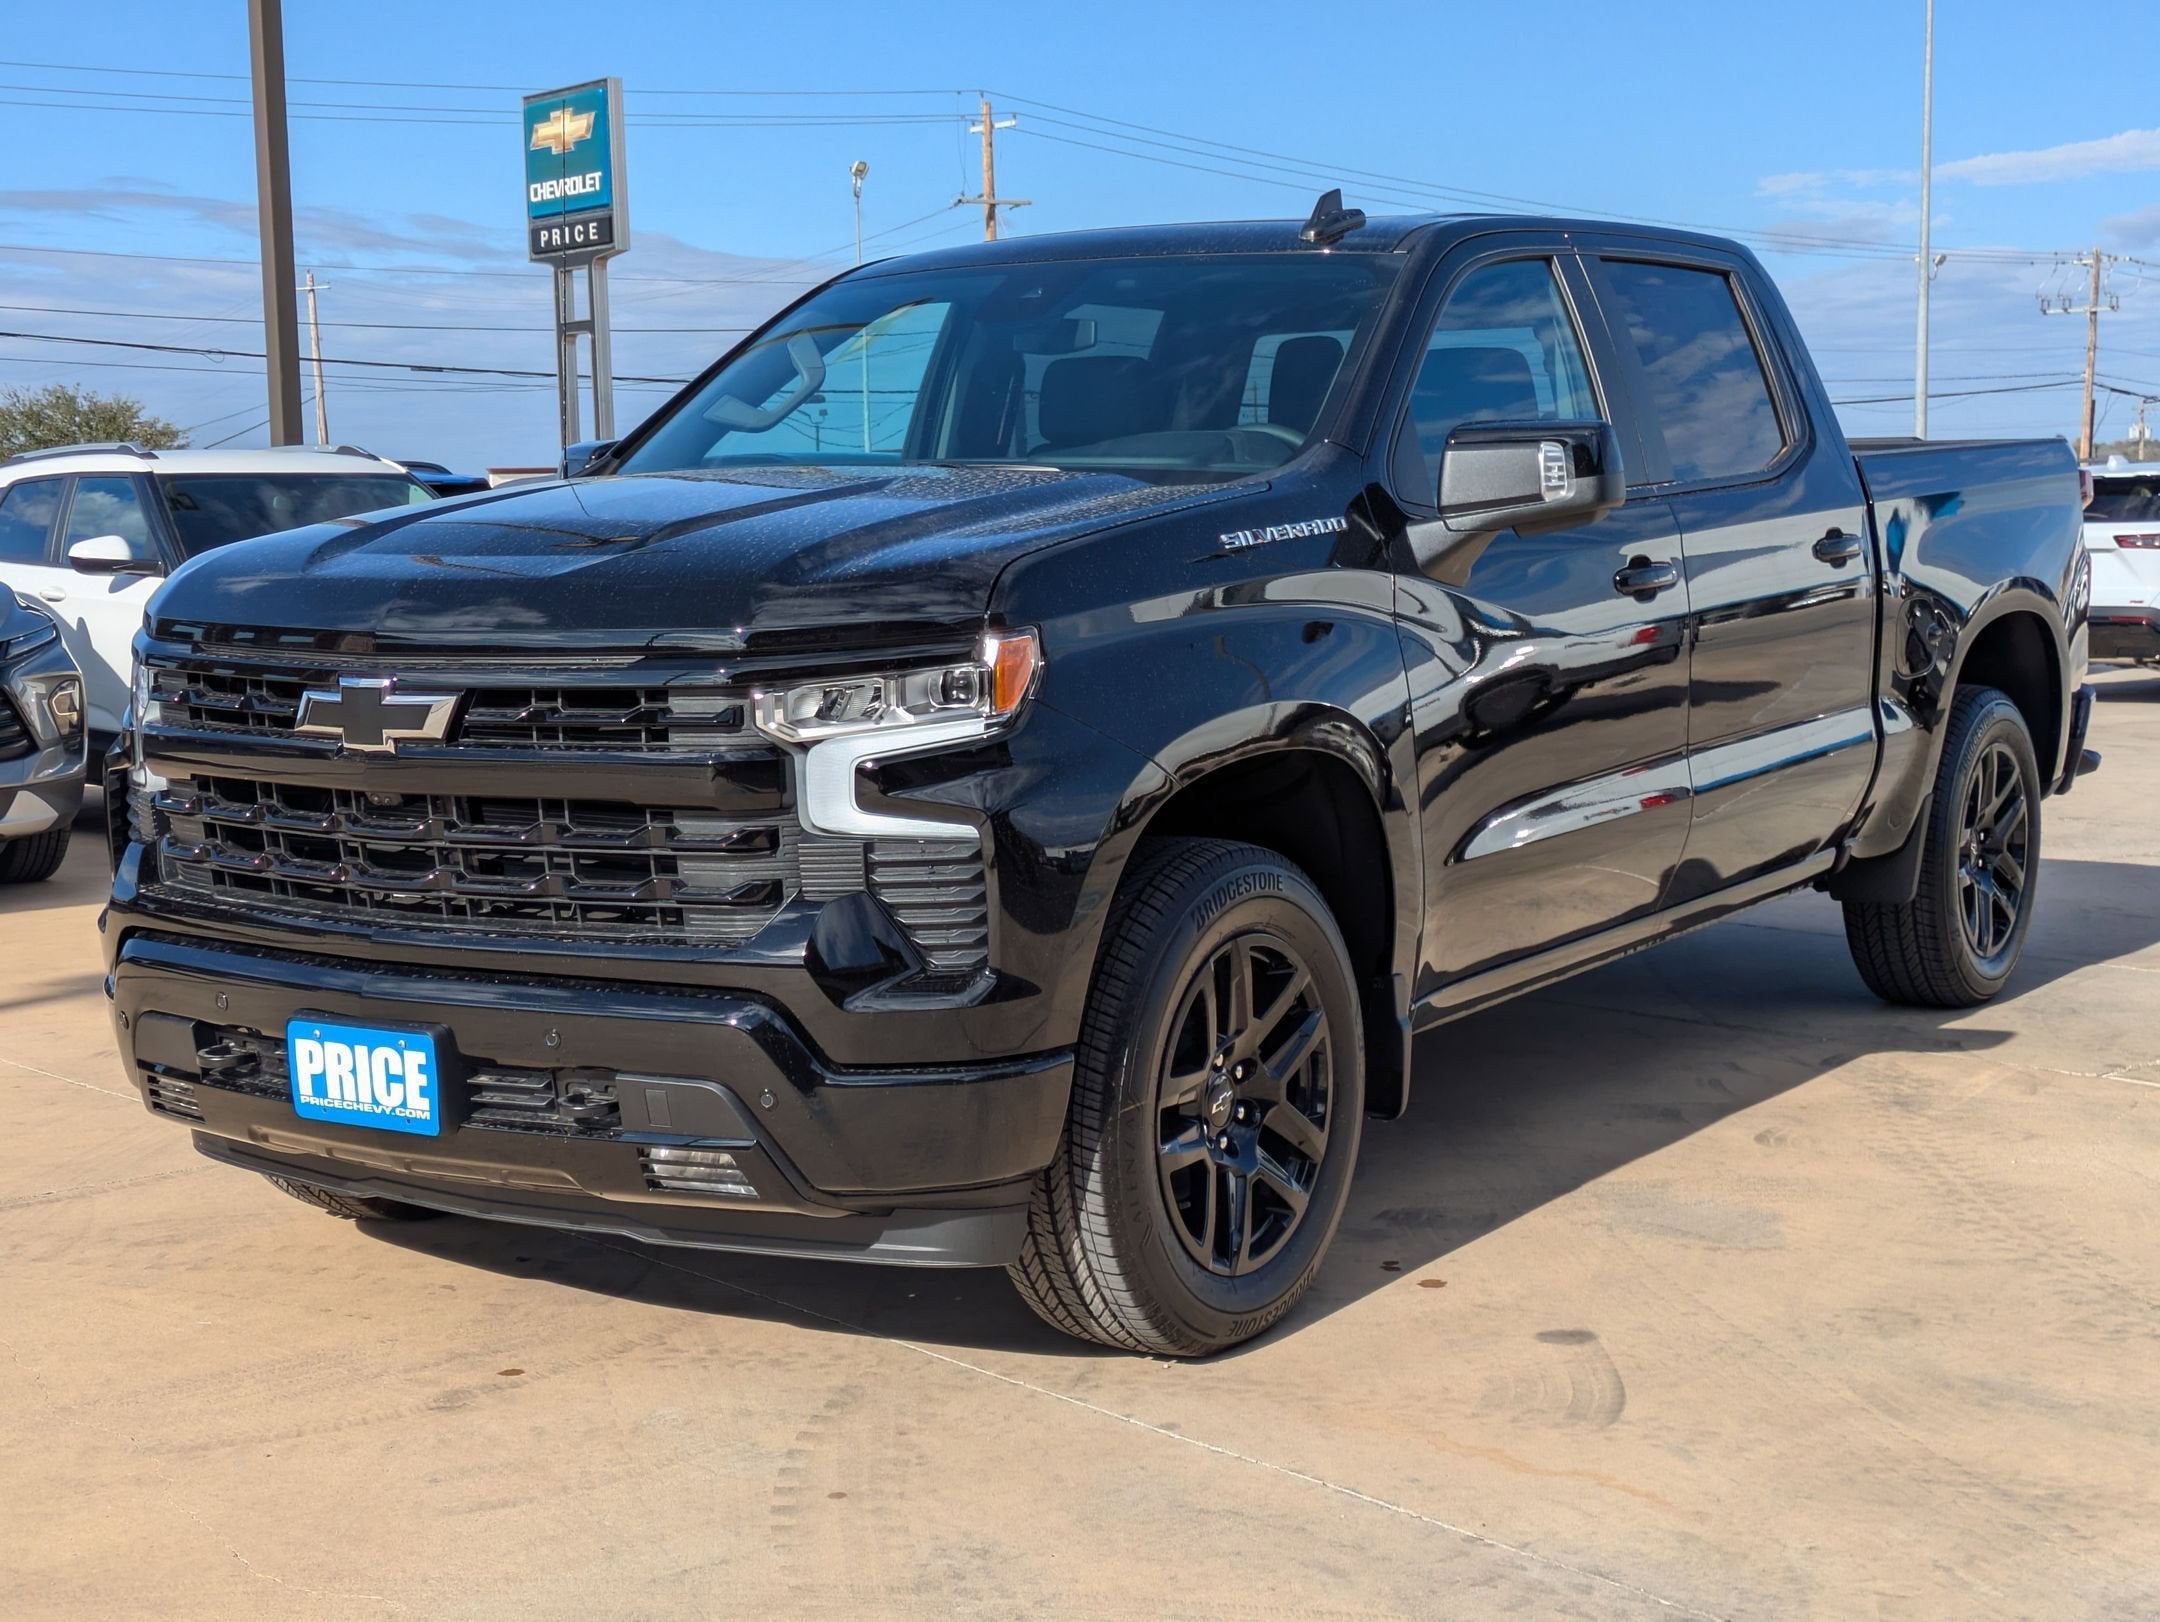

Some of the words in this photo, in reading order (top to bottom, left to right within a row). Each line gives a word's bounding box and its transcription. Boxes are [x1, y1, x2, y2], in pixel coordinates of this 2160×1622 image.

[530, 171, 602, 202] CHEVROLET
[540, 222, 599, 248] PRICE
[1220, 516, 1349, 549] SILVERADO
[1190, 871, 1284, 933] BRIDGESTONE
[295, 1038, 430, 1111] PRICE
[301, 1095, 431, 1120] PRICECHEVY.COM
